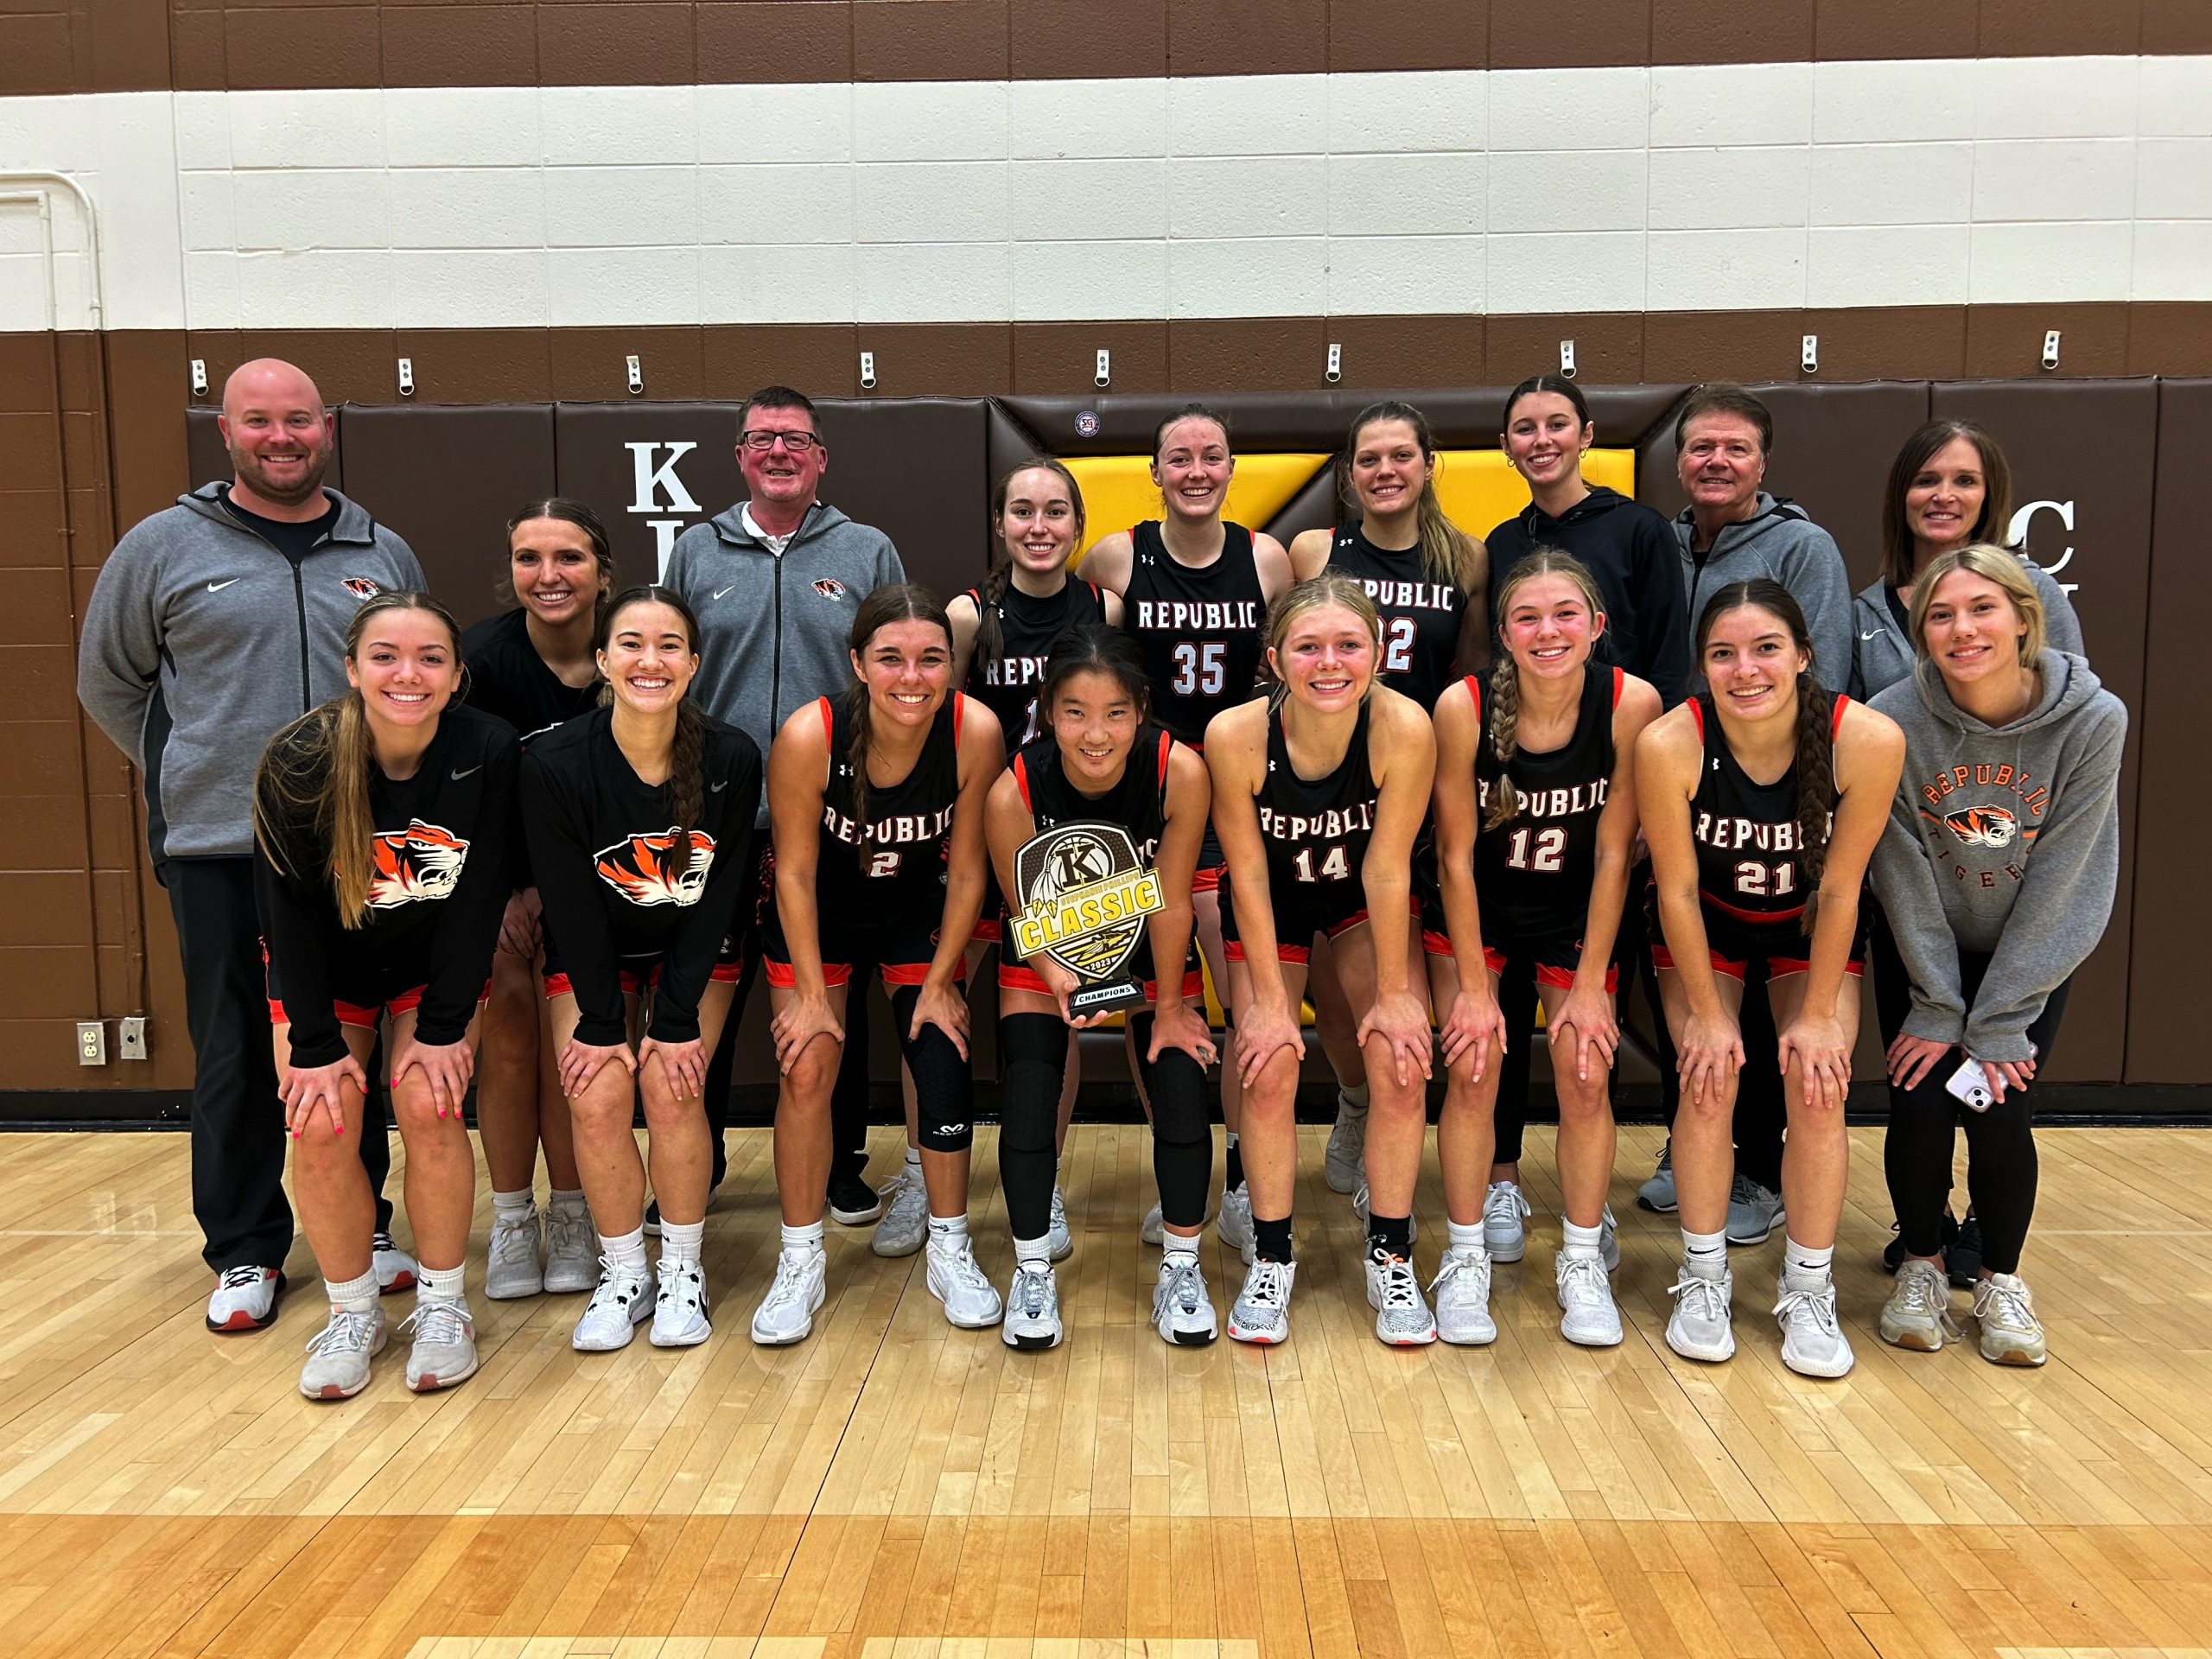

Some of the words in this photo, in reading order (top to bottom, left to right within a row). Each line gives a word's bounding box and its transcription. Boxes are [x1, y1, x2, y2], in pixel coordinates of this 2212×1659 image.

[1137, 601, 1257, 629] REPUBLIC
[1376, 617, 1415, 671] 2
[1173, 643, 1226, 696] 35
[1478, 778, 1608, 817] RPUBLIC
[1921, 763, 2049, 816] REPUBLIC
[869, 852, 899, 878] 2
[1055, 842, 1103, 887] K
[1295, 847, 1349, 882] 14
[1509, 829, 1565, 871] 12
[1738, 862, 1794, 895] 21
[1020, 880, 1156, 950] CLASSIC
[1090, 957, 1111, 970] 2023
[1078, 986, 1131, 1002] CHAMPIONS
